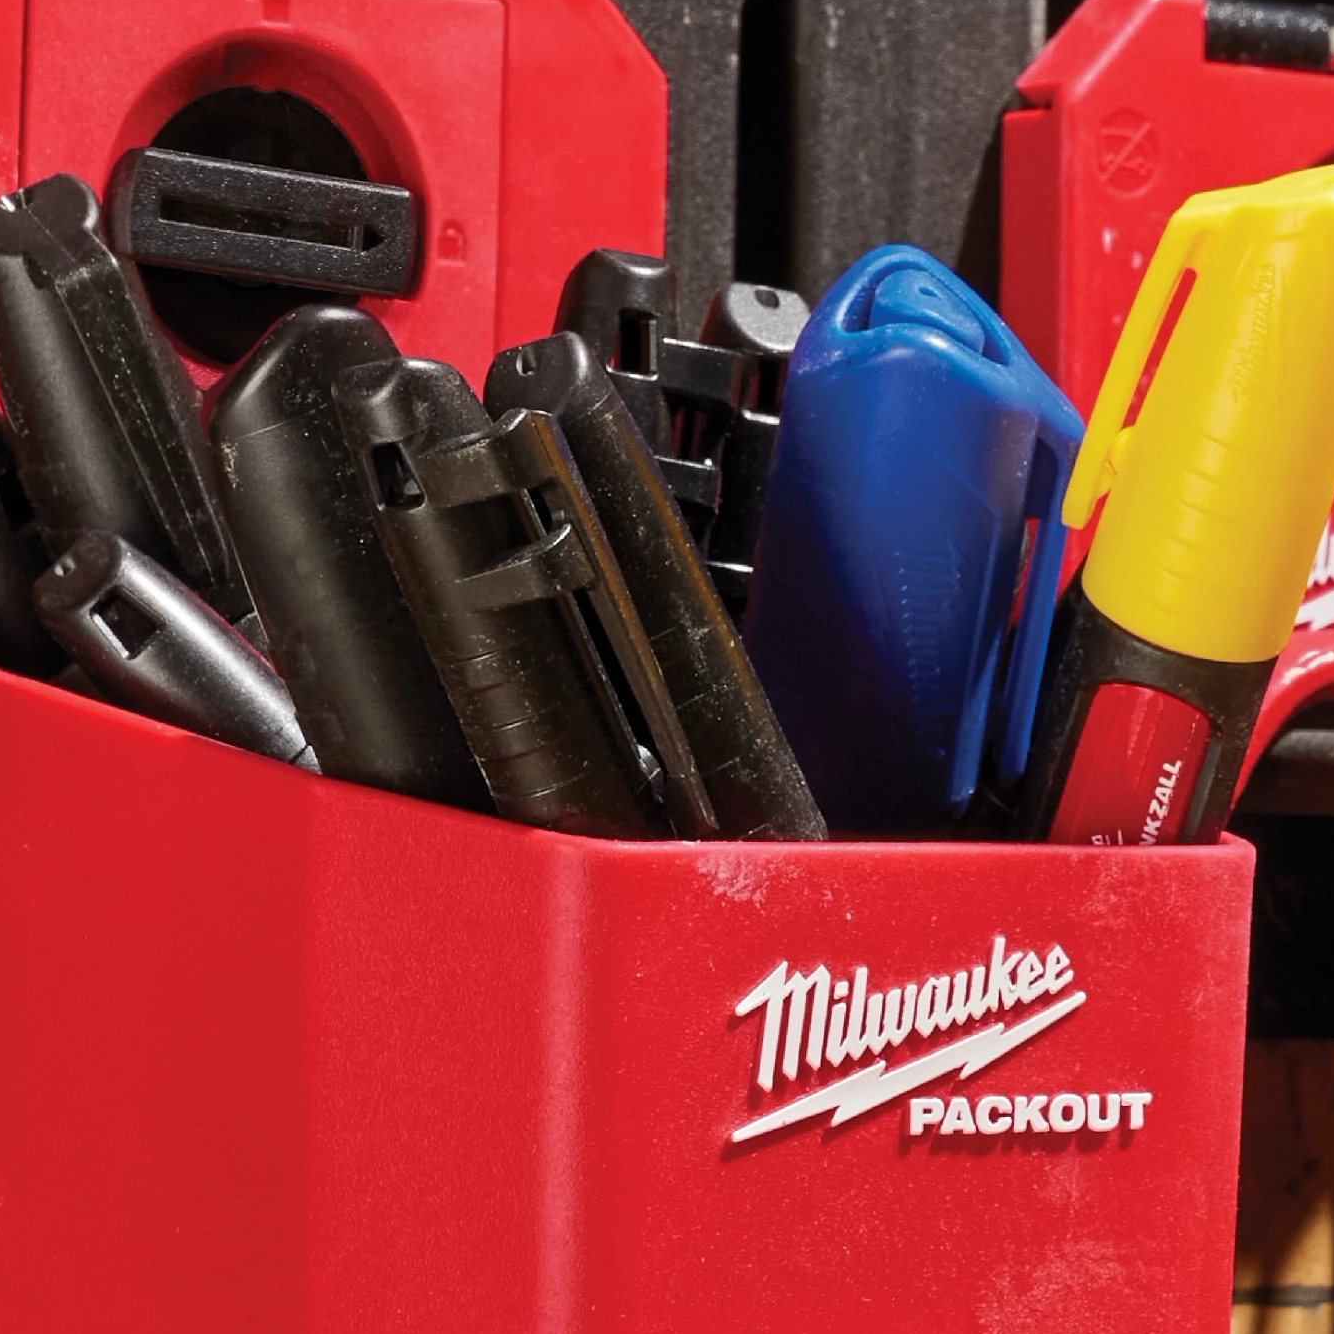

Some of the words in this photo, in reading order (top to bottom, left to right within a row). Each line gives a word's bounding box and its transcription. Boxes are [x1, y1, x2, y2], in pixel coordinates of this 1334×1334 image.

[1139, 760, 1183, 846] NKZALL
[735, 935, 1075, 1092] Milwaukee
[910, 1092, 1153, 1136] PACKOUT
